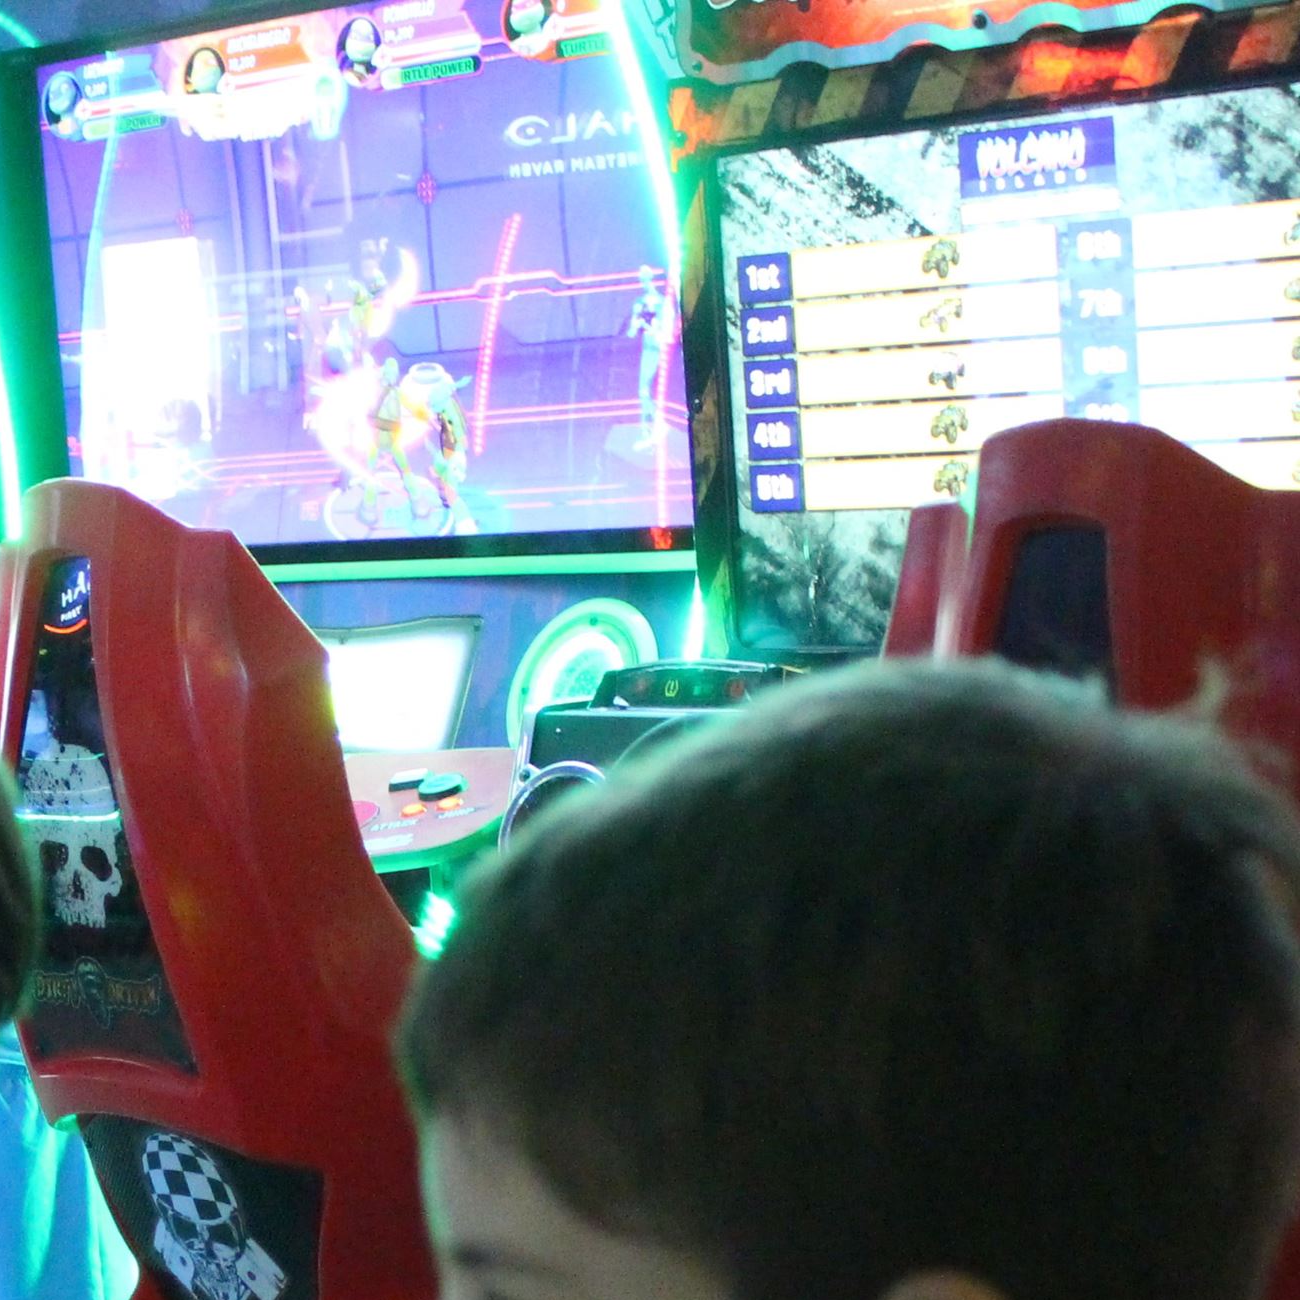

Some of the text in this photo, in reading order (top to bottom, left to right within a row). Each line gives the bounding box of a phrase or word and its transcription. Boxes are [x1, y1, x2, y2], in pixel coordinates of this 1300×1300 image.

[432, 59, 473, 79] POWER
[746, 263, 781, 291] 1st
[746, 315, 787, 345] 2nd
[750, 368, 791, 397] 3rd
[753, 420, 791, 448] 4th
[756, 472, 795, 501] 5th
